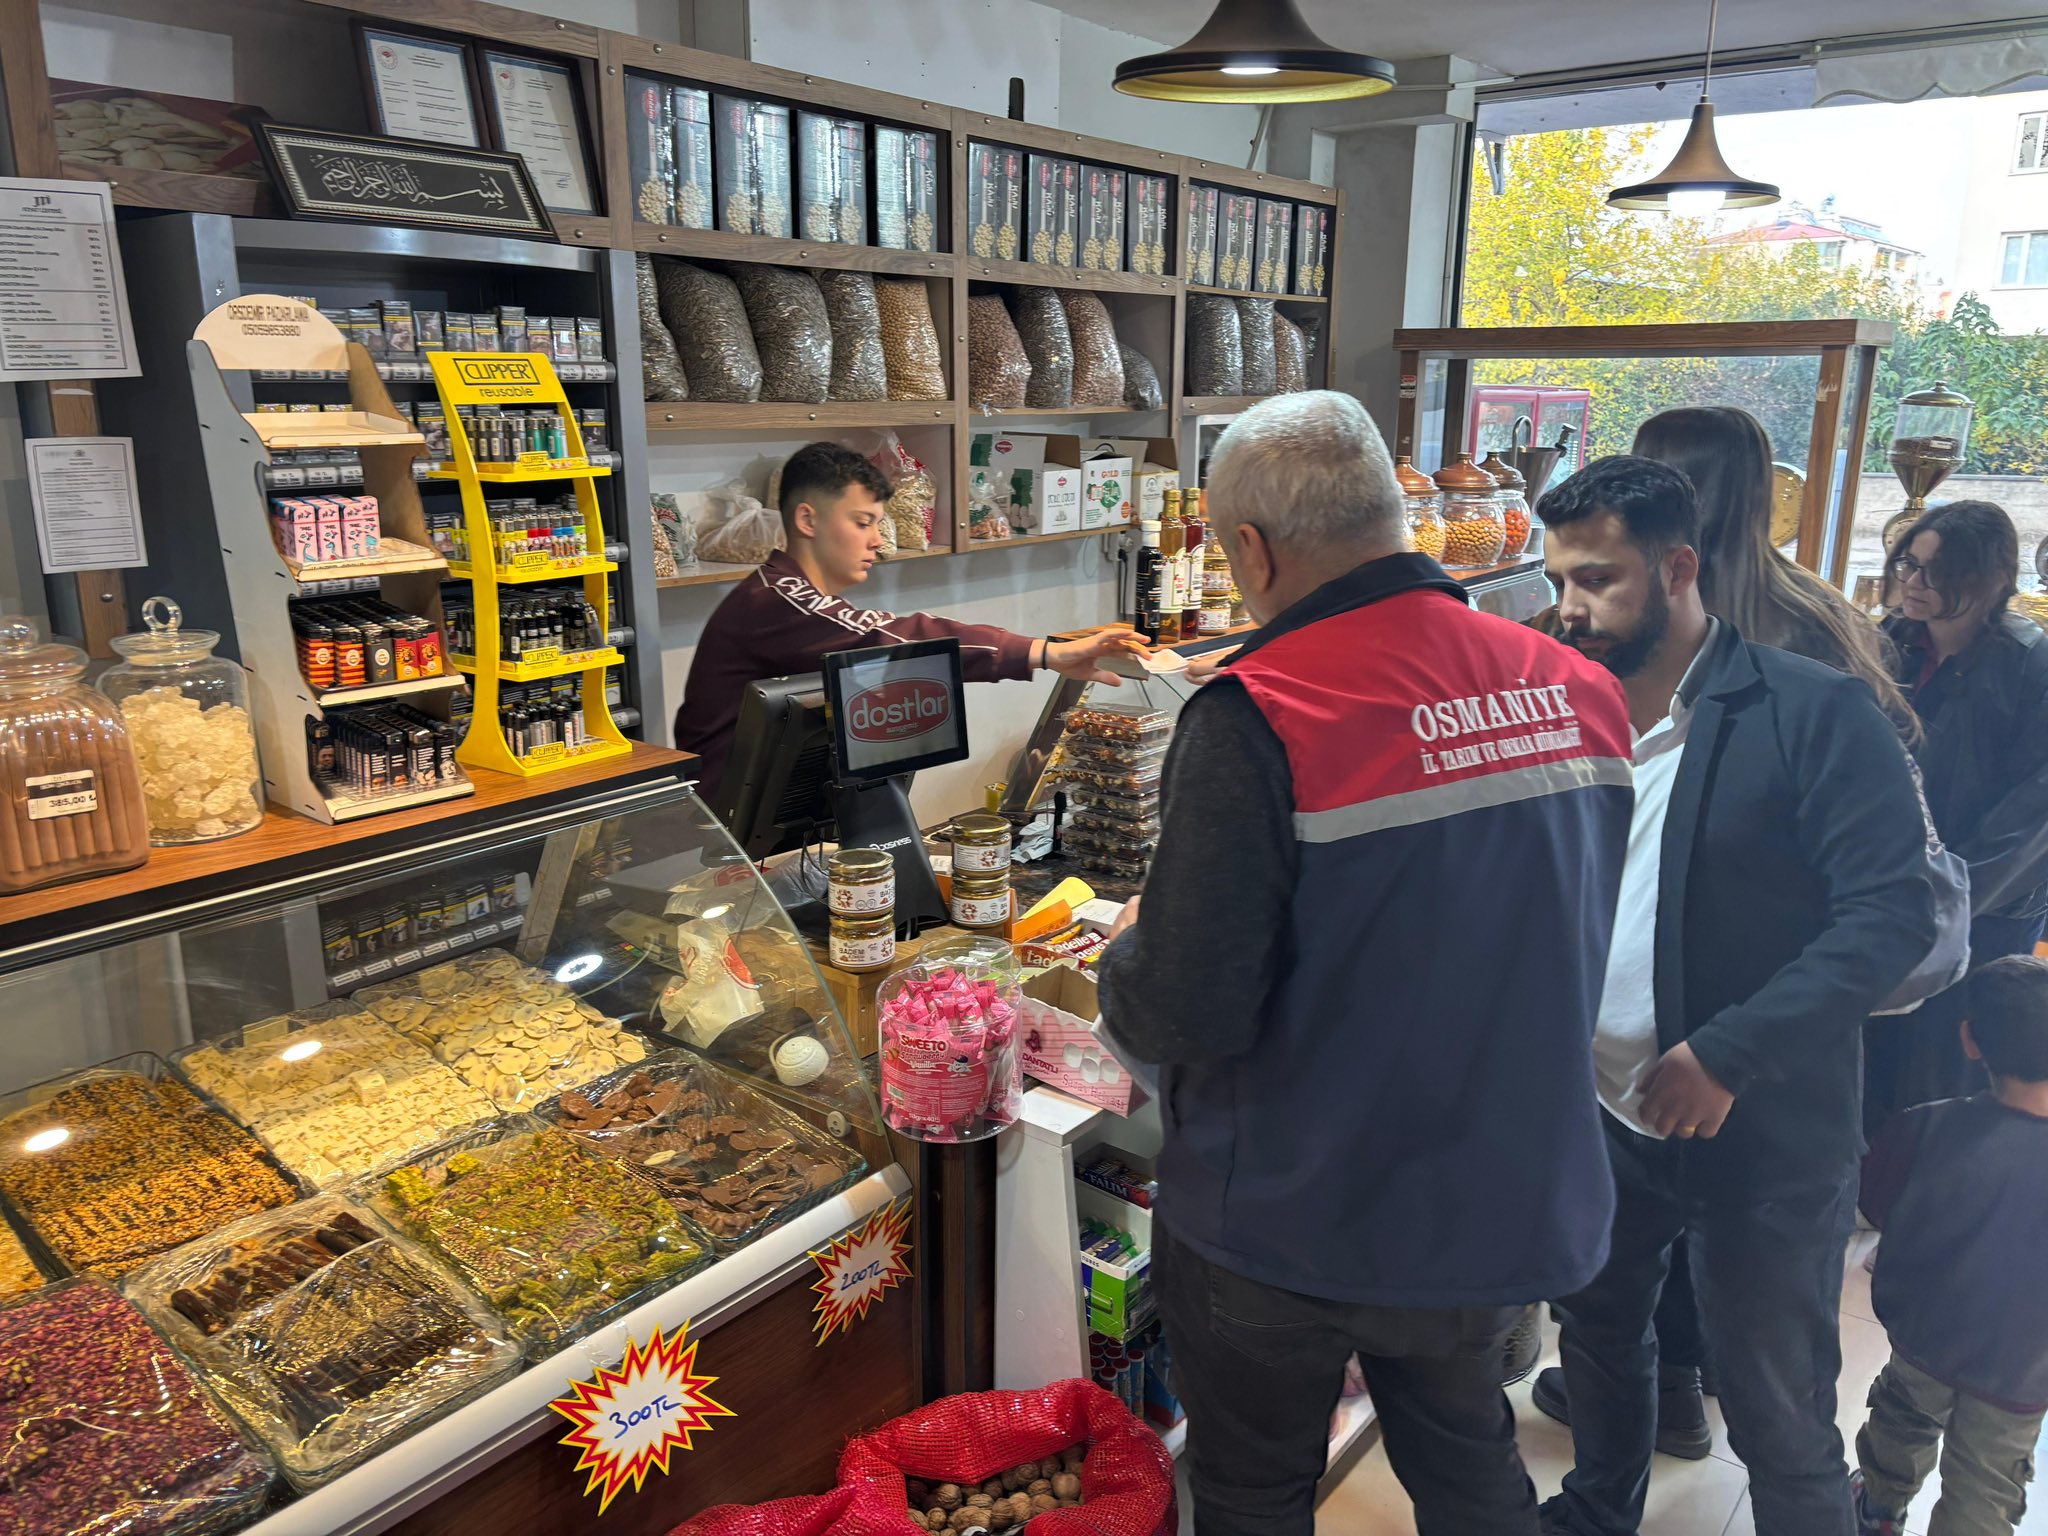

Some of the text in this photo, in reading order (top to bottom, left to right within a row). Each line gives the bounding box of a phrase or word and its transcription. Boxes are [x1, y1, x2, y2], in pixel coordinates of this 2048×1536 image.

[696, 134, 706, 164] KAJU
[854, 160, 862, 187] KAJU
[925, 169, 935, 196] KAJU
[986, 182, 995, 207] KAJU
[1011, 184, 1020, 209] KAJU
[464, 363, 531, 381] CLIPPER
[479, 387, 535, 398] reusable
[852, 688, 947, 730] dostlar
[1411, 678, 1576, 742] OSMANİYE
[1421, 748, 1440, 775] İL
[1480, 742, 1501, 762] VE
[900, 1034, 947, 1052] SWEETO
[910, 1060, 937, 1069] Vanilla
[1090, 1174, 1128, 1197] FALIM
[840, 1260, 890, 1291] 200TL
[609, 1394, 683, 1440] 300TL
